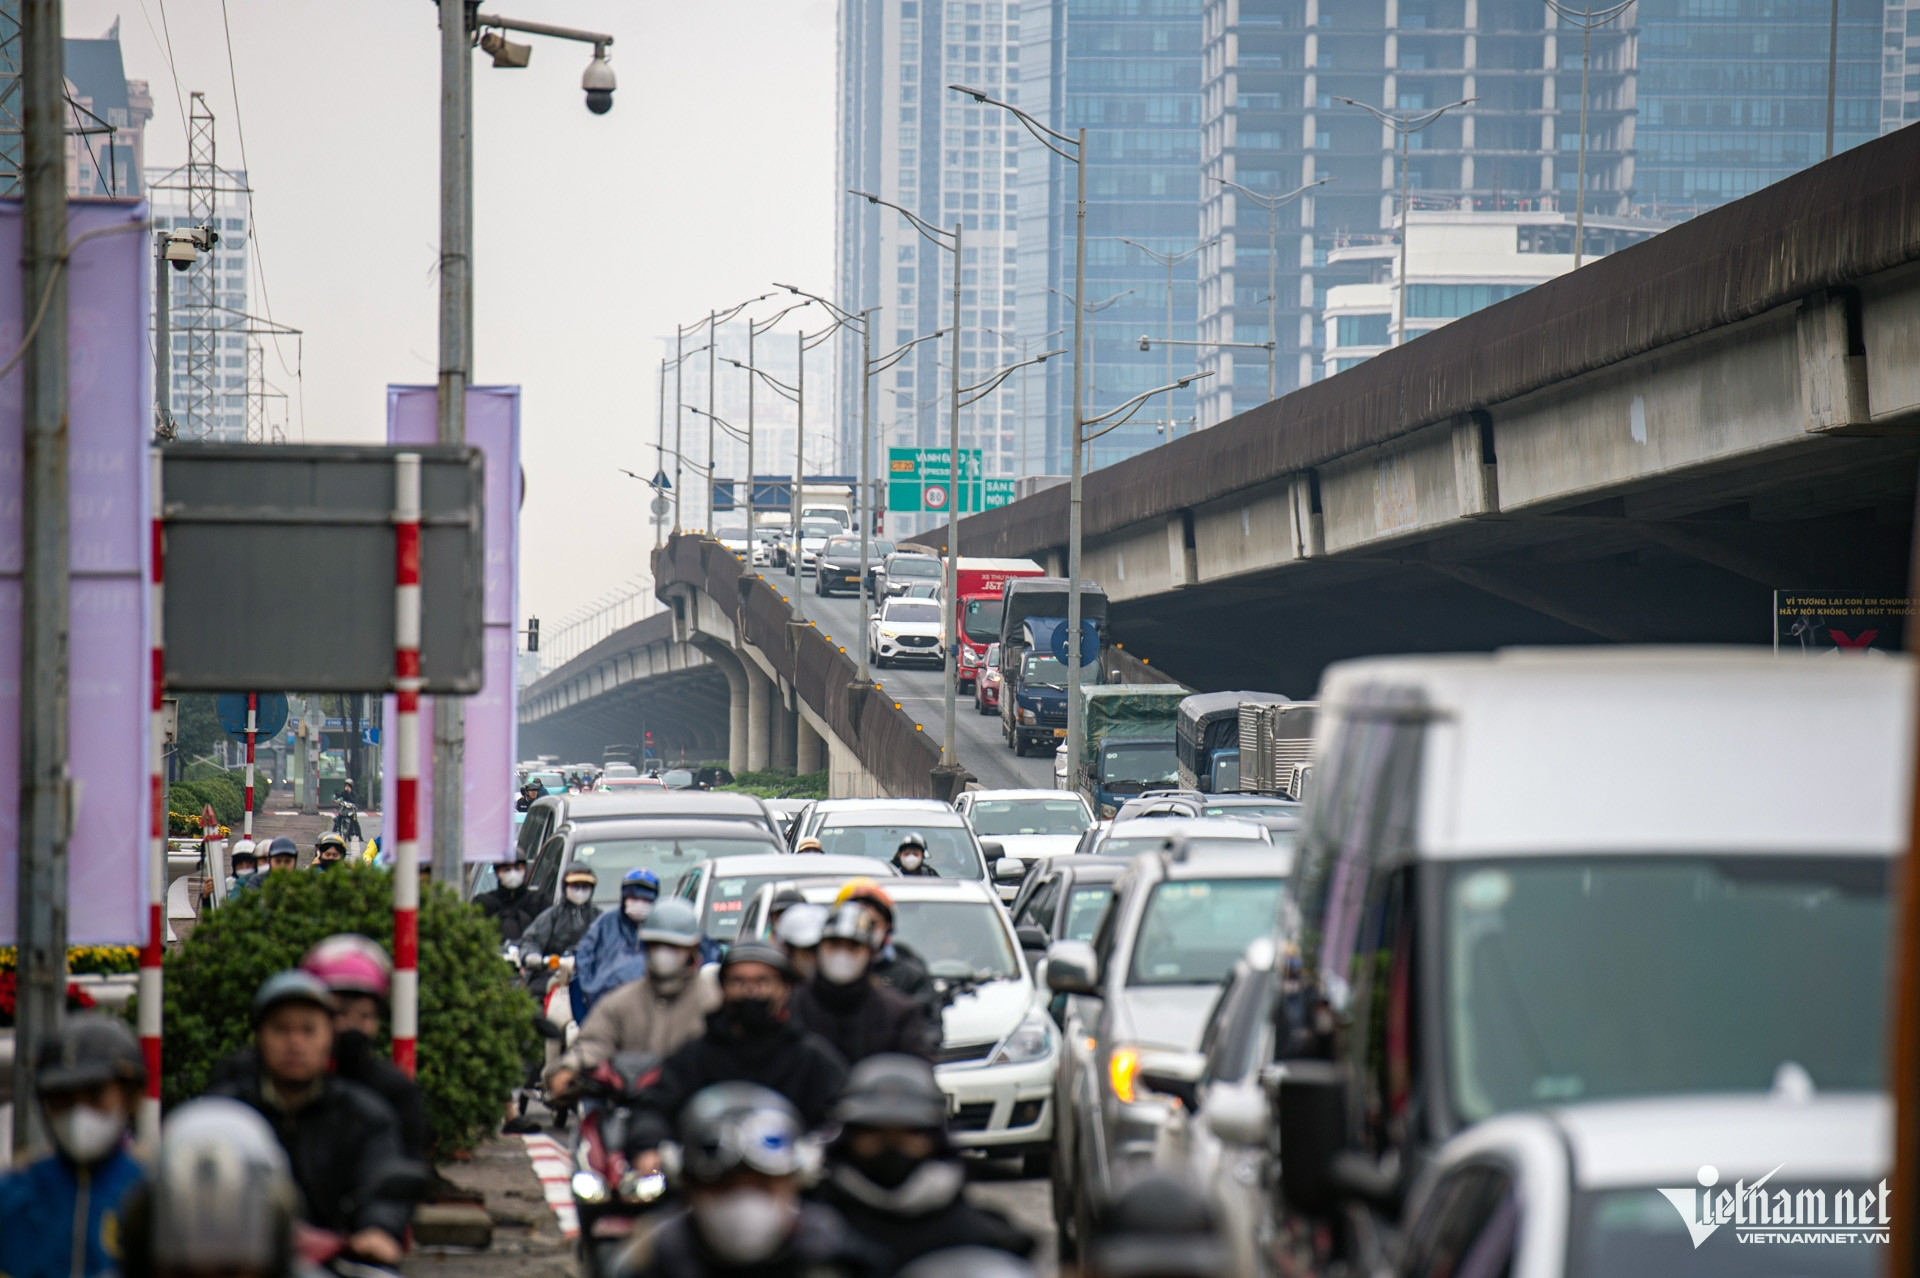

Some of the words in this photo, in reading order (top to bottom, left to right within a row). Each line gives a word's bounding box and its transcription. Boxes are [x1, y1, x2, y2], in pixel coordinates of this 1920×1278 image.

[929, 491, 942, 502] 80
[981, 581, 1004, 590] J&T
[1828, 598, 1843, 606] LAI
[1844, 598, 1863, 606] CON
[1865, 598, 1878, 606] EM
[1817, 607, 1848, 616] KHÔNG
